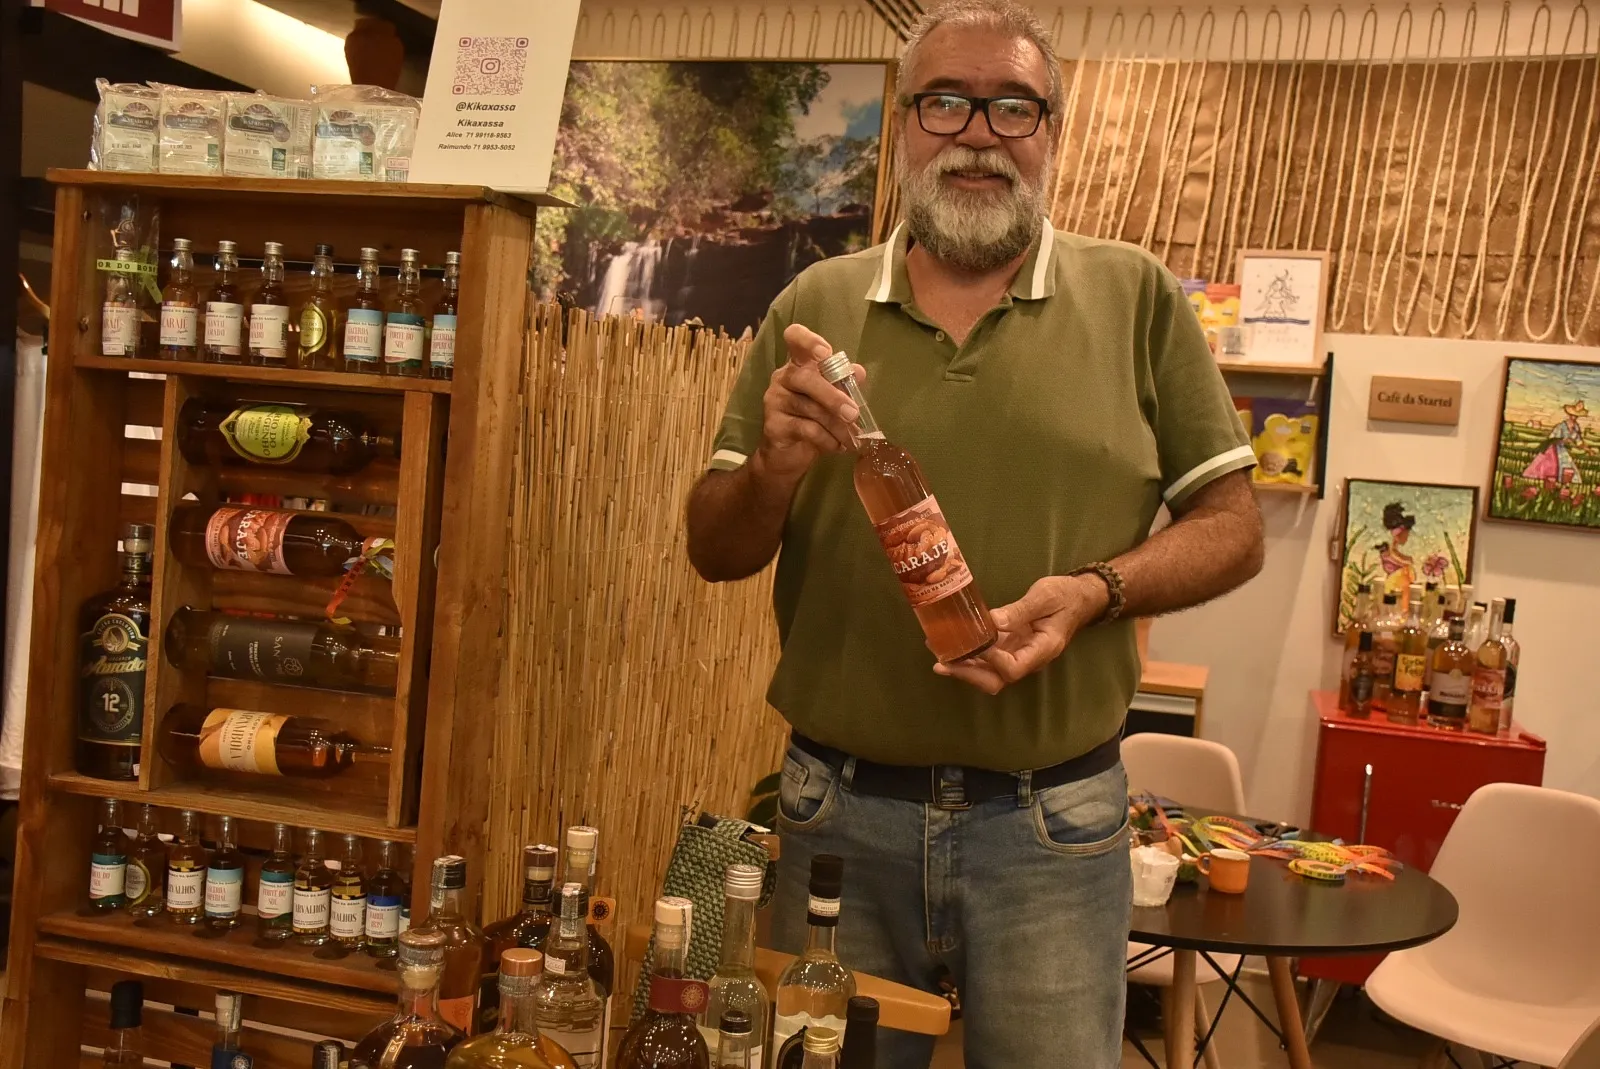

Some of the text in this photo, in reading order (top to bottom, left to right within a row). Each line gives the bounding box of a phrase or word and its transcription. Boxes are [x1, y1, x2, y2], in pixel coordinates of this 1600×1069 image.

[456, 101, 516, 112] @Kikaxassa
[457, 119, 504, 128] Kikaxassa
[117, 262, 131, 270] DO
[1377, 390, 1400, 404] Café
[1402, 393, 1415, 405] da
[262, 412, 272, 456] NGENHO
[269, 432, 277, 448] DO
[102, 692, 120, 712] 12
